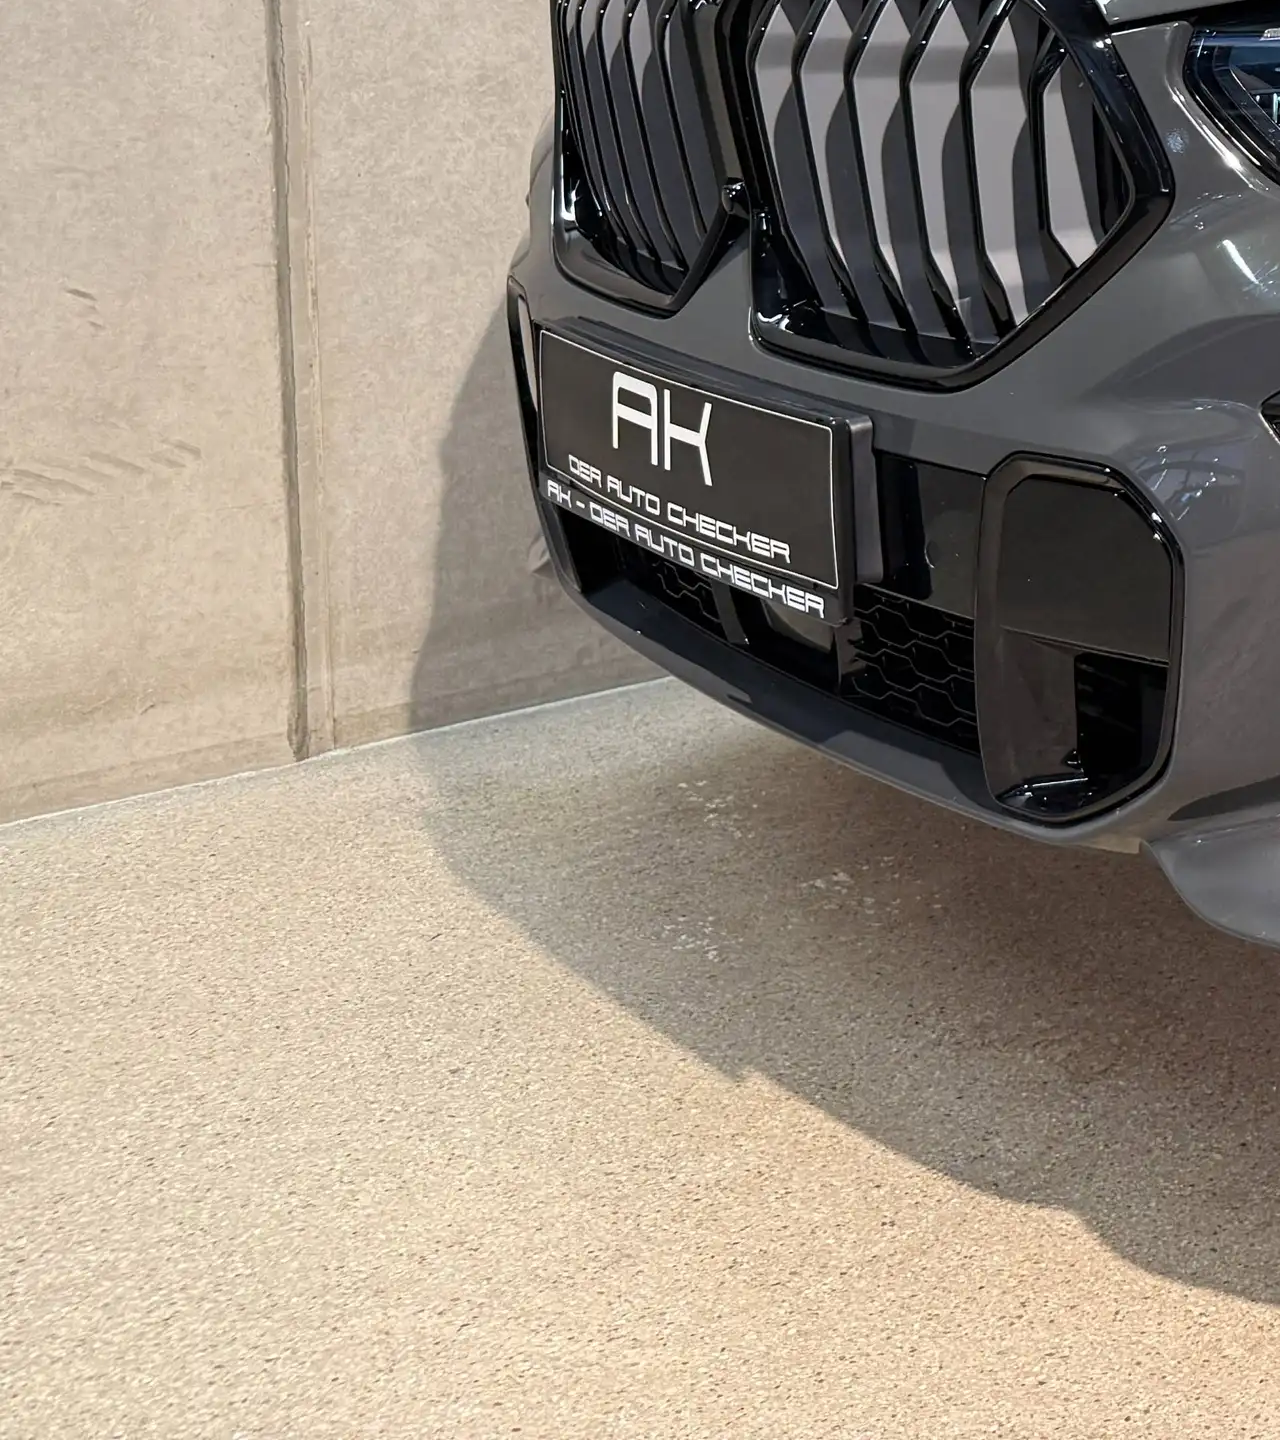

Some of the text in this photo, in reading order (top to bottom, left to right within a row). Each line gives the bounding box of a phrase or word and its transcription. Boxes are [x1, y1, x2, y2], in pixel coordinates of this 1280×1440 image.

[612, 371, 713, 486] AK
[547, 479, 572, 509] AK
[589, 503, 630, 538] DER
[635, 524, 695, 566] AUTO
[700, 552, 825, 618] CHECKER
[568, 454, 791, 564] DER AUTO CHECKER
